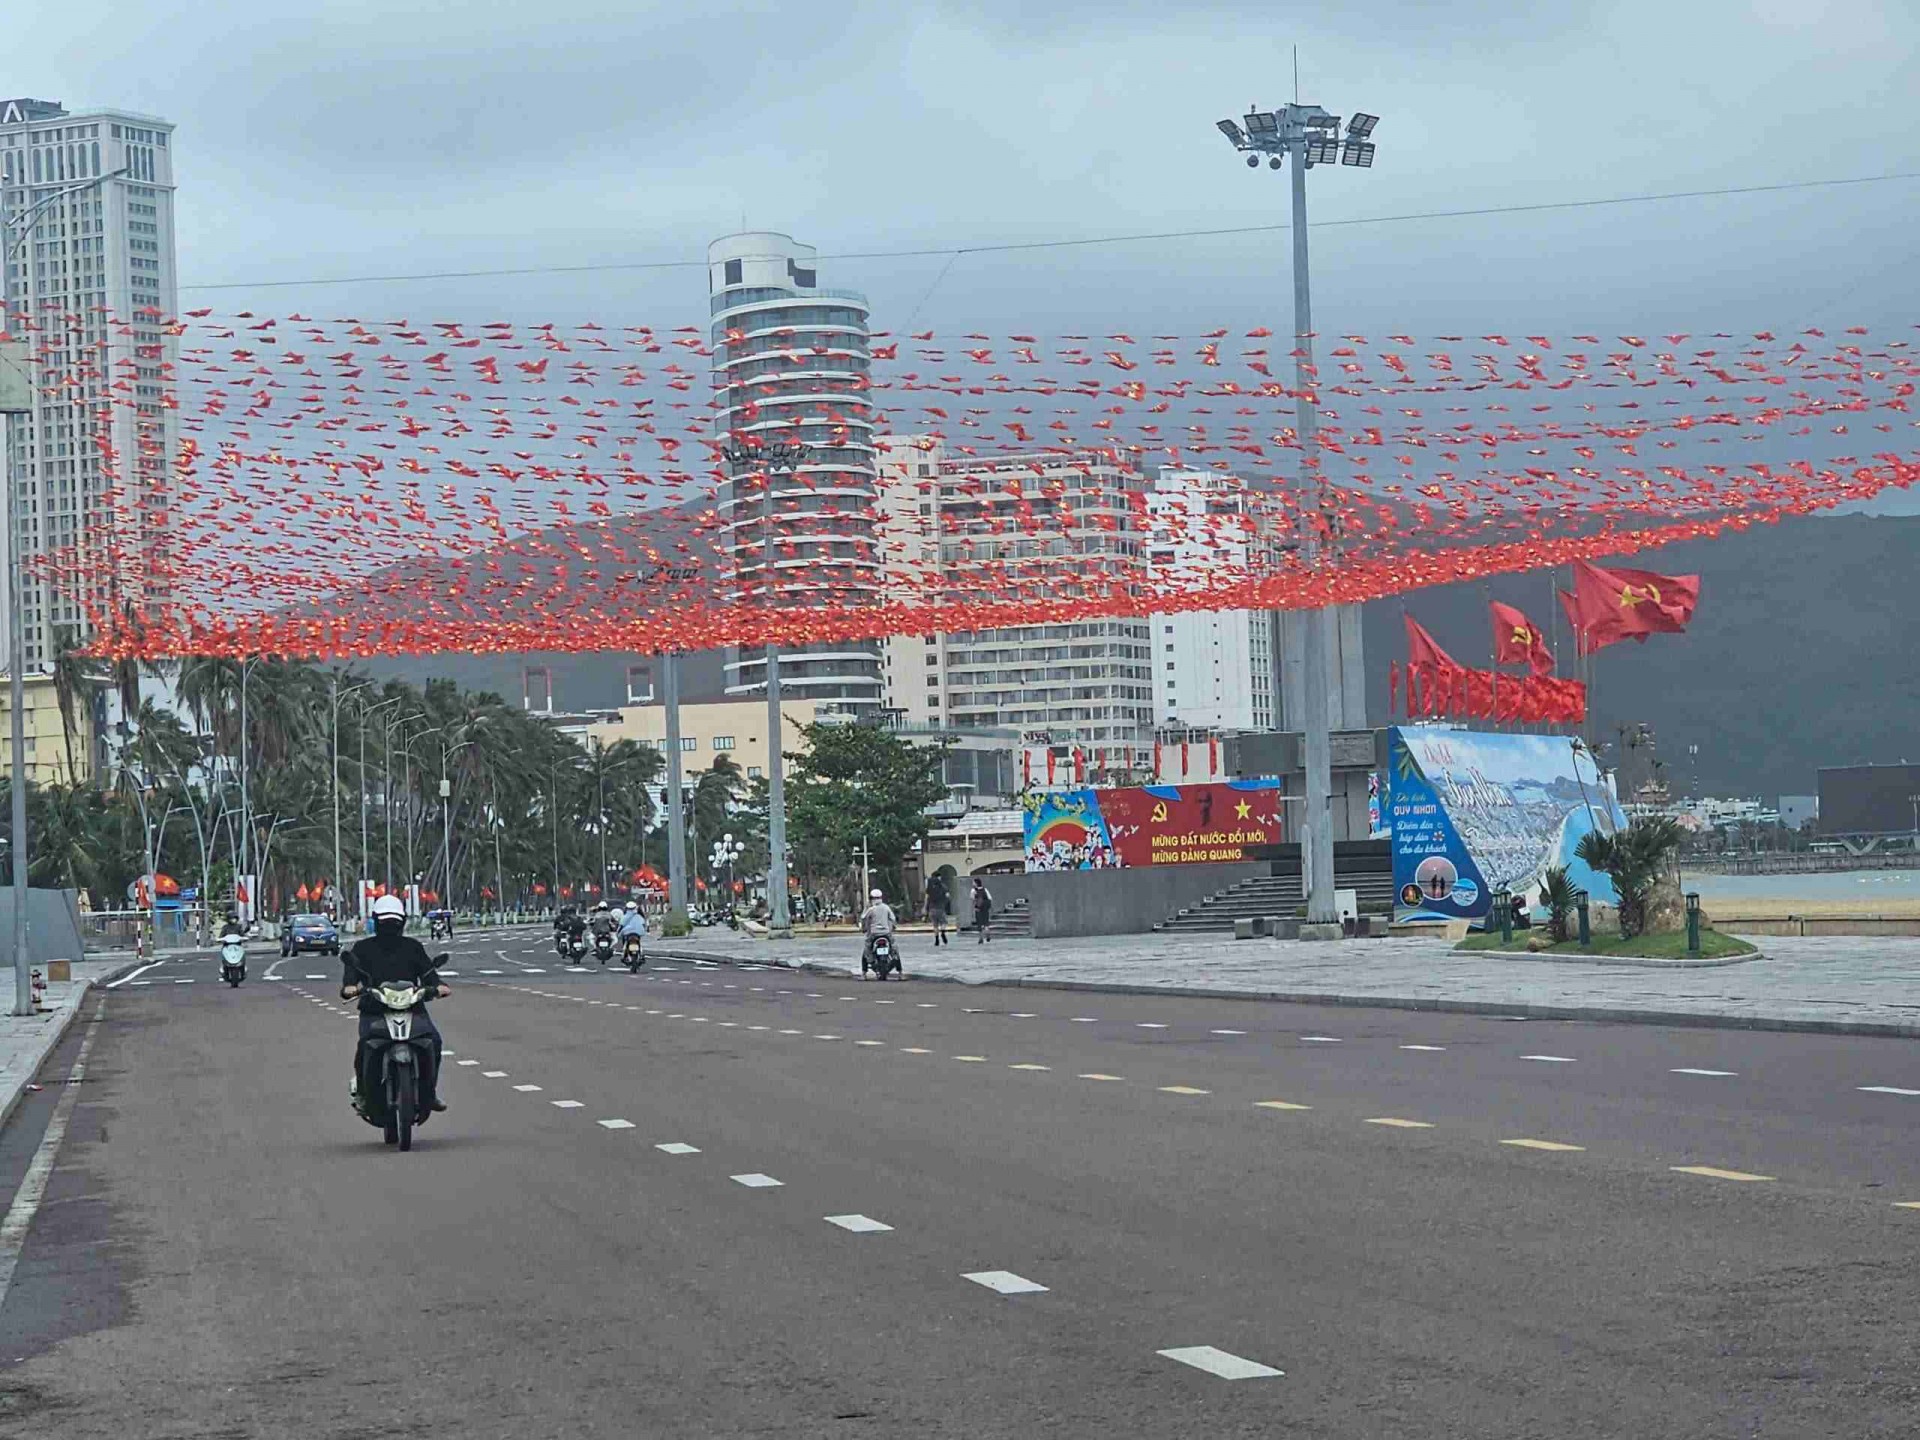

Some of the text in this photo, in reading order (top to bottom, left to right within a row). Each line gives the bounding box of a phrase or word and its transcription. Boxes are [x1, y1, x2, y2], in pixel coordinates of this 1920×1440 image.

[1394, 805, 1411, 816] QUY
[1152, 827, 1267, 847] MỪNG ĐẤT NƯỚC ĐỔI MỚI,
[1152, 847, 1242, 863] MỪNG ĐẢNG QUANG
